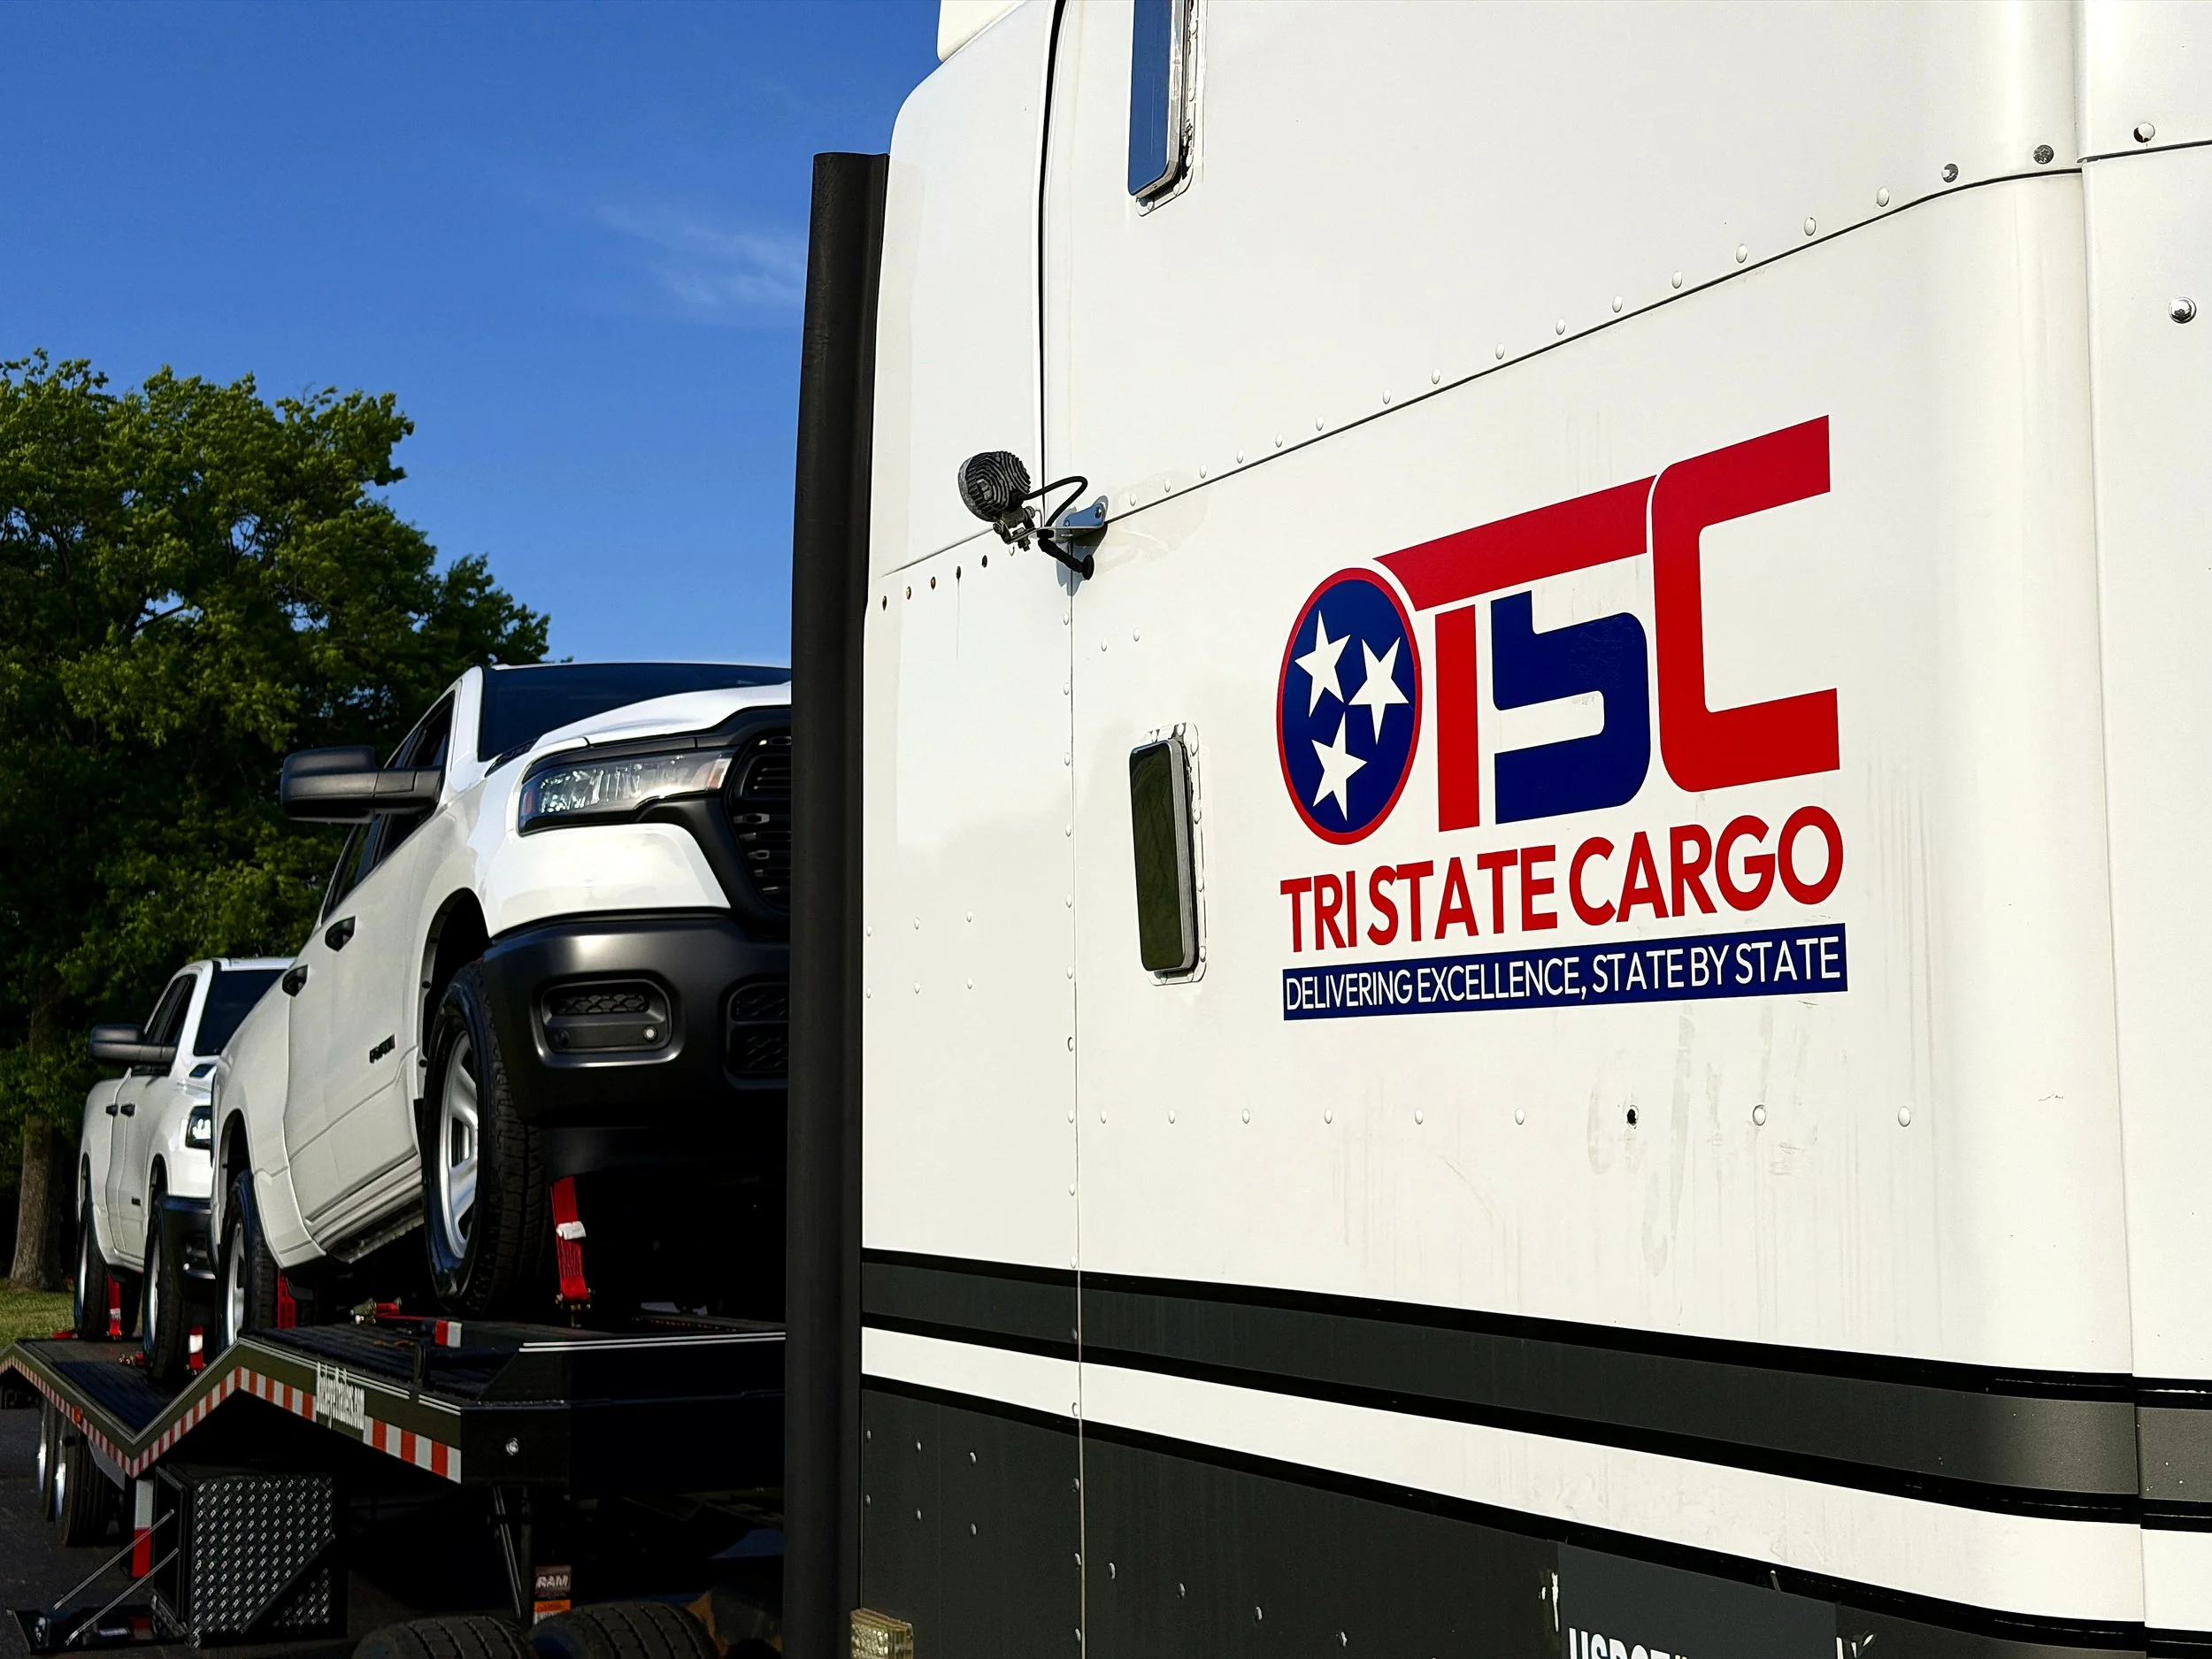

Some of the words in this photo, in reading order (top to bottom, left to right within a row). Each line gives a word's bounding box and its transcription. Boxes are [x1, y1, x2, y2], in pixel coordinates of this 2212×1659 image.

[1280, 870, 1357, 953] TRI
[1367, 843, 1558, 946] STATE
[1569, 805, 1844, 926] CARGO
[1286, 968, 1413, 1010] DELIVERING
[1417, 956, 1587, 1003] EXCELLENCE,
[1593, 948, 1685, 993] STATE
[1690, 944, 1730, 987] BY
[1735, 936, 1841, 984] STATE
[535, 1575, 569, 1589] RAM
